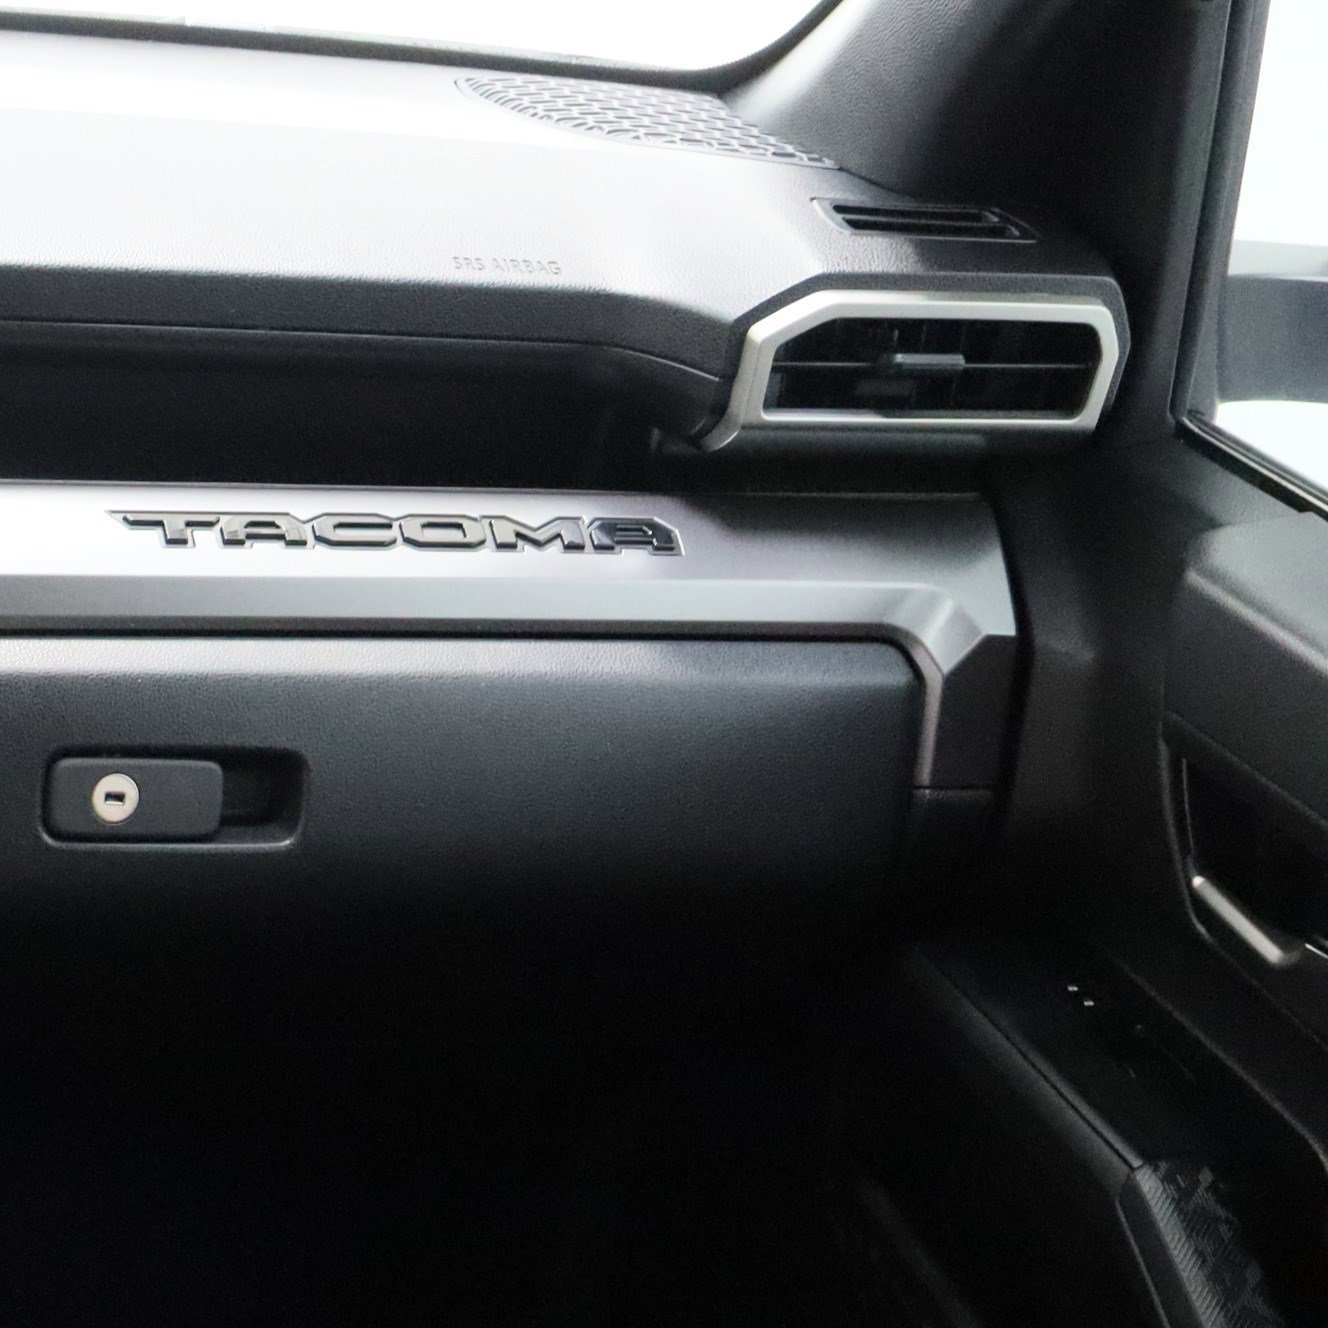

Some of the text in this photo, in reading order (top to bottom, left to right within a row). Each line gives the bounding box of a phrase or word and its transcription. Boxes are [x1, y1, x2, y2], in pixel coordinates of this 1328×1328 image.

[451, 255, 563, 275] SRS AIRBAG
[104, 509, 686, 557] TACOMA
